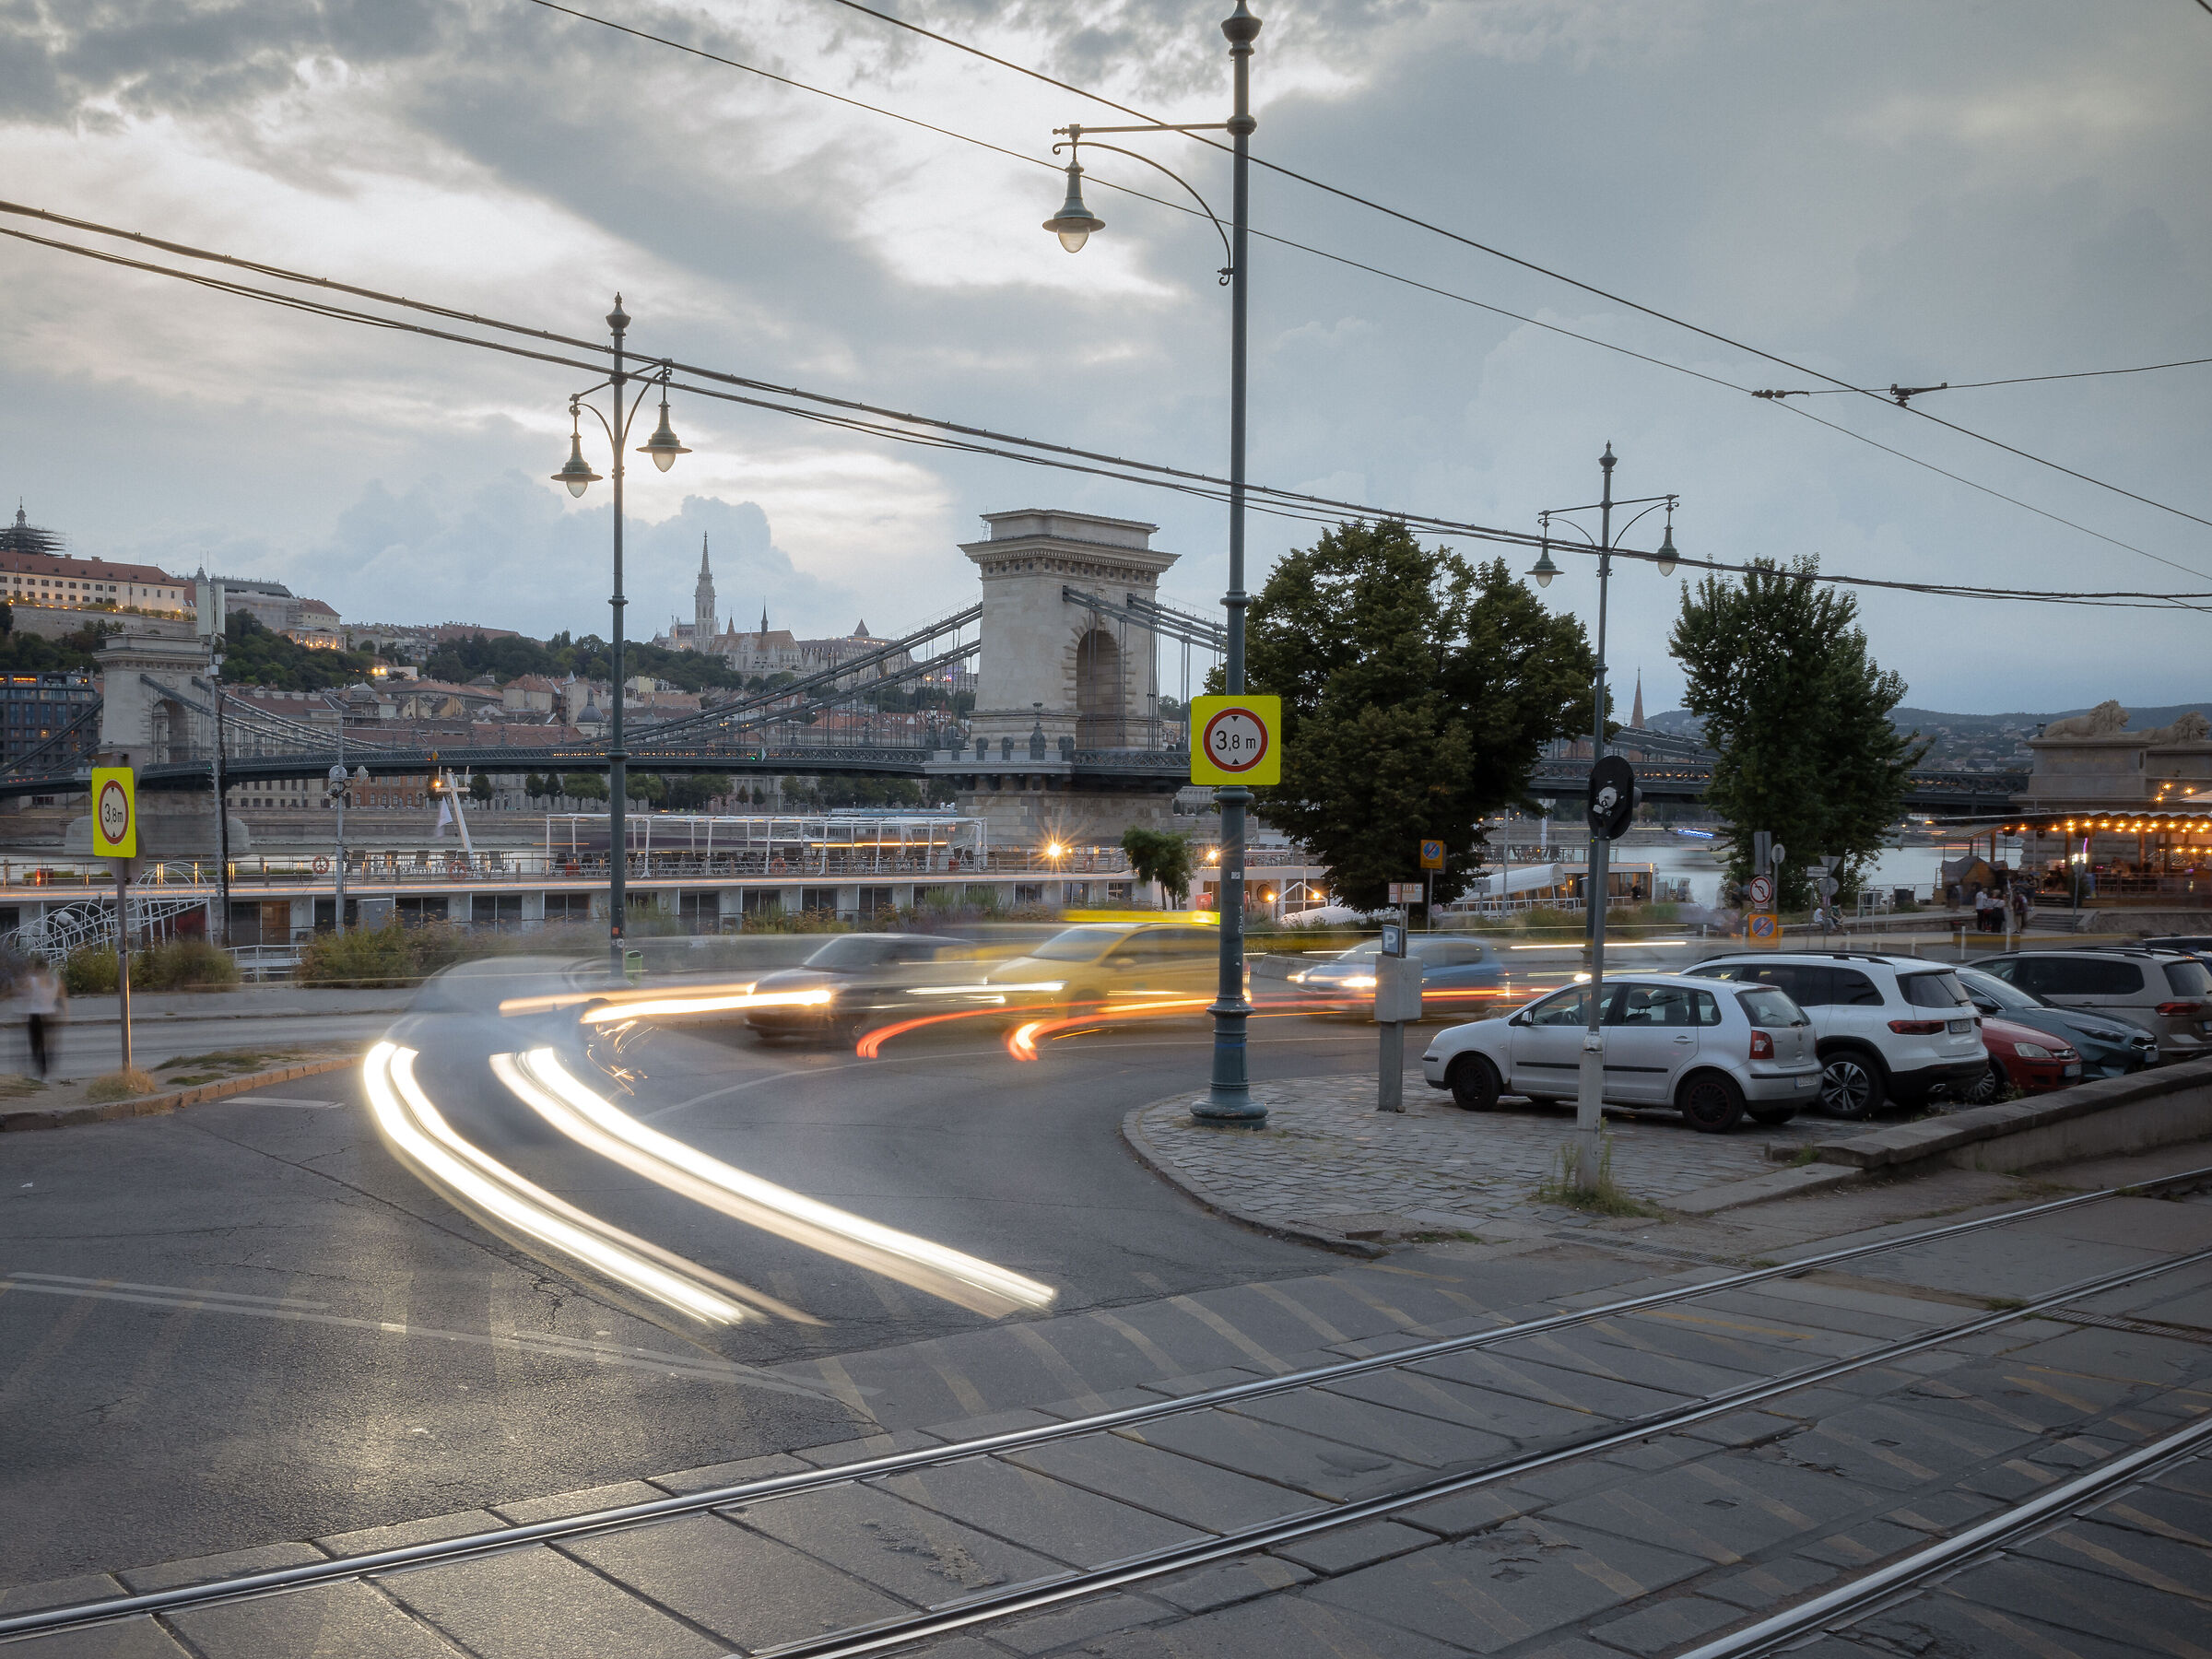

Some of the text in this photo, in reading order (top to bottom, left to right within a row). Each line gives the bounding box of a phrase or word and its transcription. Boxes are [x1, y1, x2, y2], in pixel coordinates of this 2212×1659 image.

[1215, 730, 1256, 751] 3,8 m
[1384, 931, 1396, 948] P
